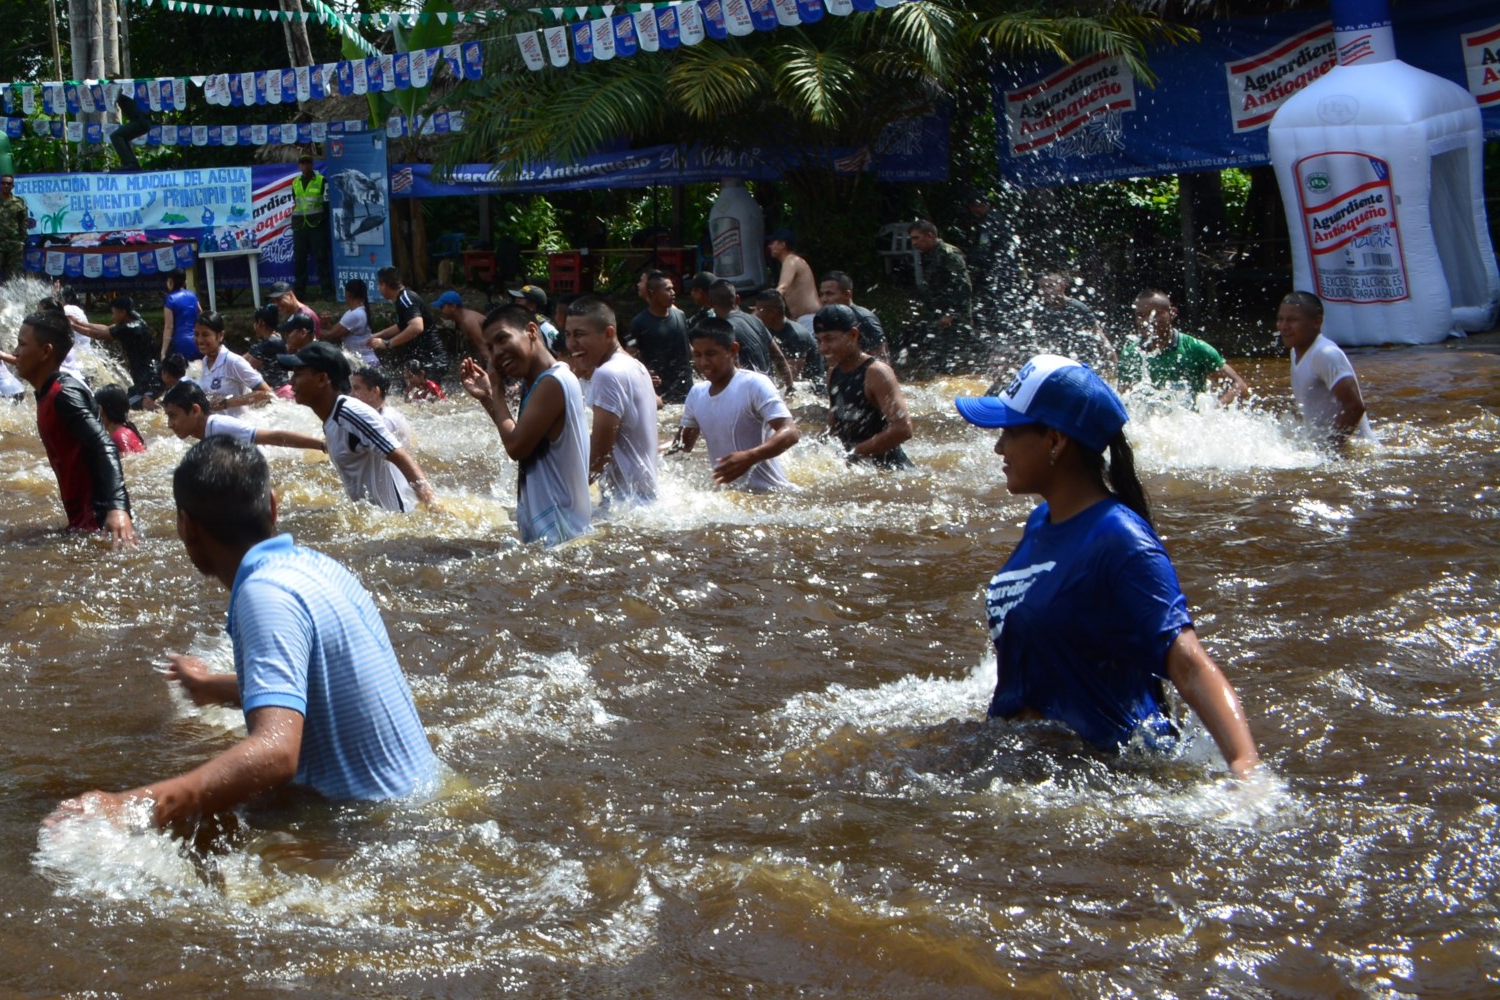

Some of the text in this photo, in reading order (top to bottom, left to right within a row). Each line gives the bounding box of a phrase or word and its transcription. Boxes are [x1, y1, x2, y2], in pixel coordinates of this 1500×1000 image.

[1020, 65, 1118, 119] Aguardiente
[1020, 81, 1122, 136] Antioqueño
[538, 155, 652, 181] Antioqueño
[1188, 158, 1212, 168] SALUD
[126, 173, 179, 191] MUNDIAL
[184, 170, 204, 187] DEL
[208, 168, 247, 184] AGUA
[231, 186, 247, 203] DE
[103, 210, 144, 228] VIDA
[1313, 193, 1384, 230] Aguardiente
[1314, 205, 1387, 243] Antioqueño
[350, 272, 358, 280] SE
[359, 272, 369, 280] VA
[370, 272, 376, 280] A
[1392, 275, 1402, 285] ES
